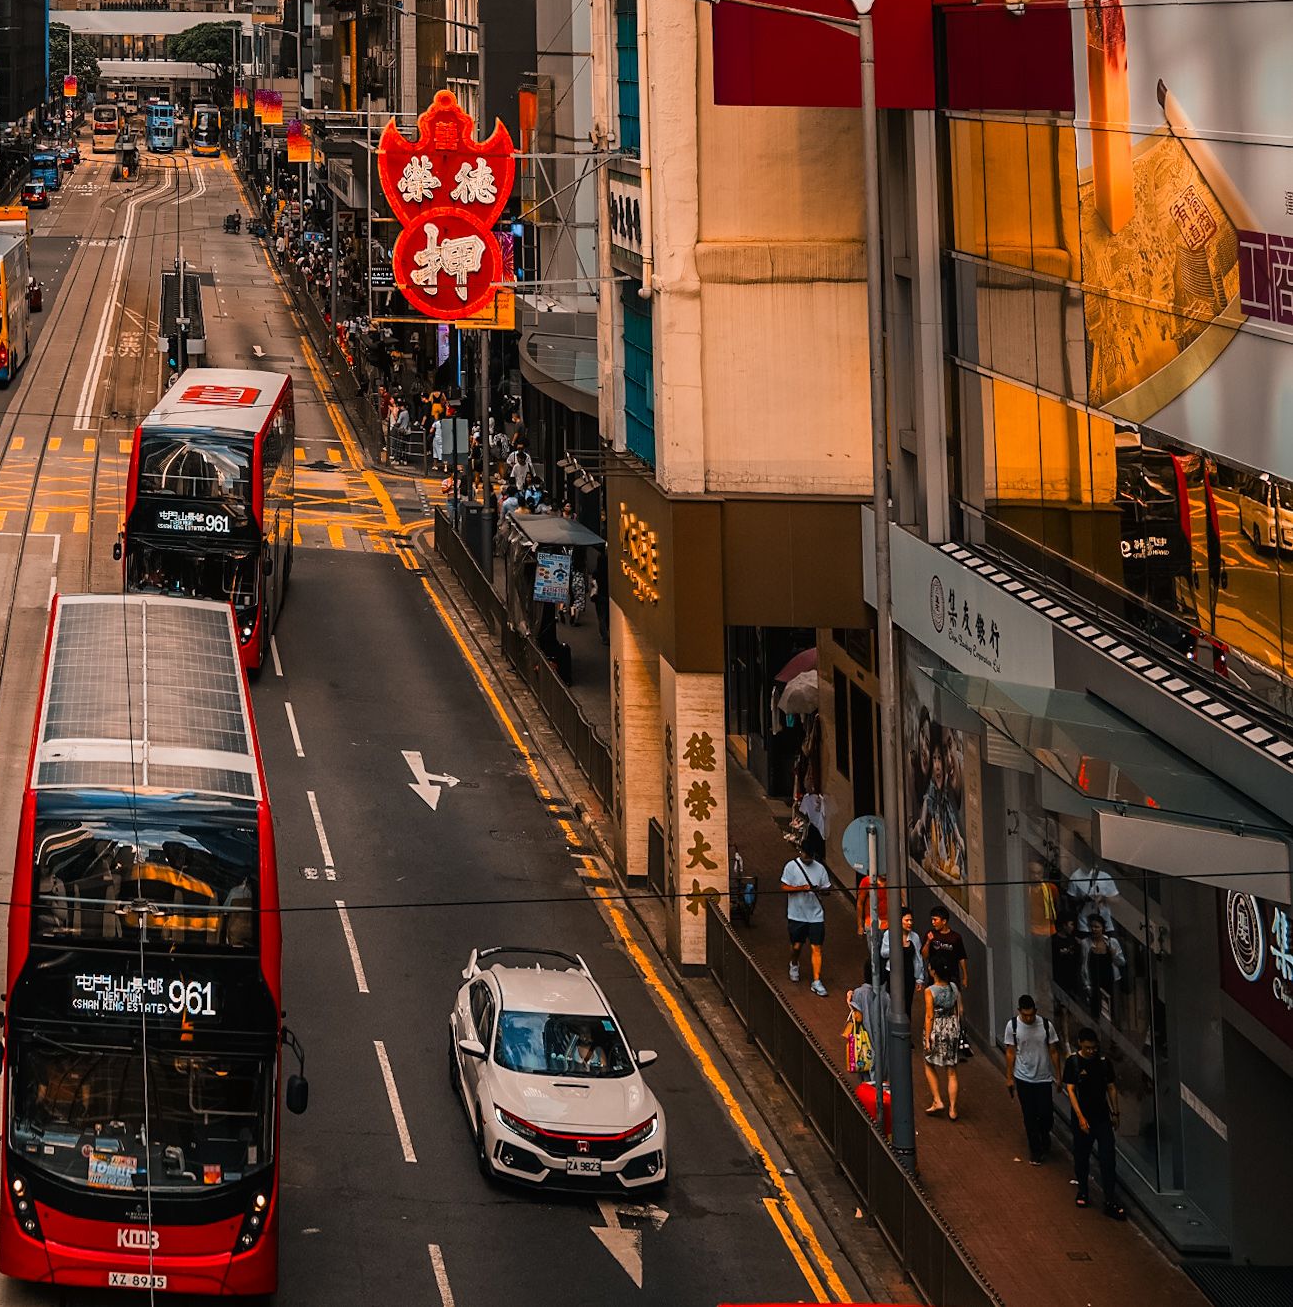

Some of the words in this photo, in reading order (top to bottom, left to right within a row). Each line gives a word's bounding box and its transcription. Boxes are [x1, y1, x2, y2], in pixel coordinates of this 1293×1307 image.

[410, 223, 486, 301] 押
[206, 515, 230, 532] 961
[948, 588, 1000, 658] 集友銀行
[683, 731, 721, 916] 德榮大押
[75, 973, 164, 995] 屯門山景邨
[96, 991, 120, 1001] TUEN
[123, 993, 141, 1003] MUN
[102, 1001, 125, 1012] KING
[168, 980, 216, 1016] 961
[568, 1161, 578, 1171] ZA
[117, 1228, 160, 1250] KMB
[111, 1274, 127, 1285] XZ
